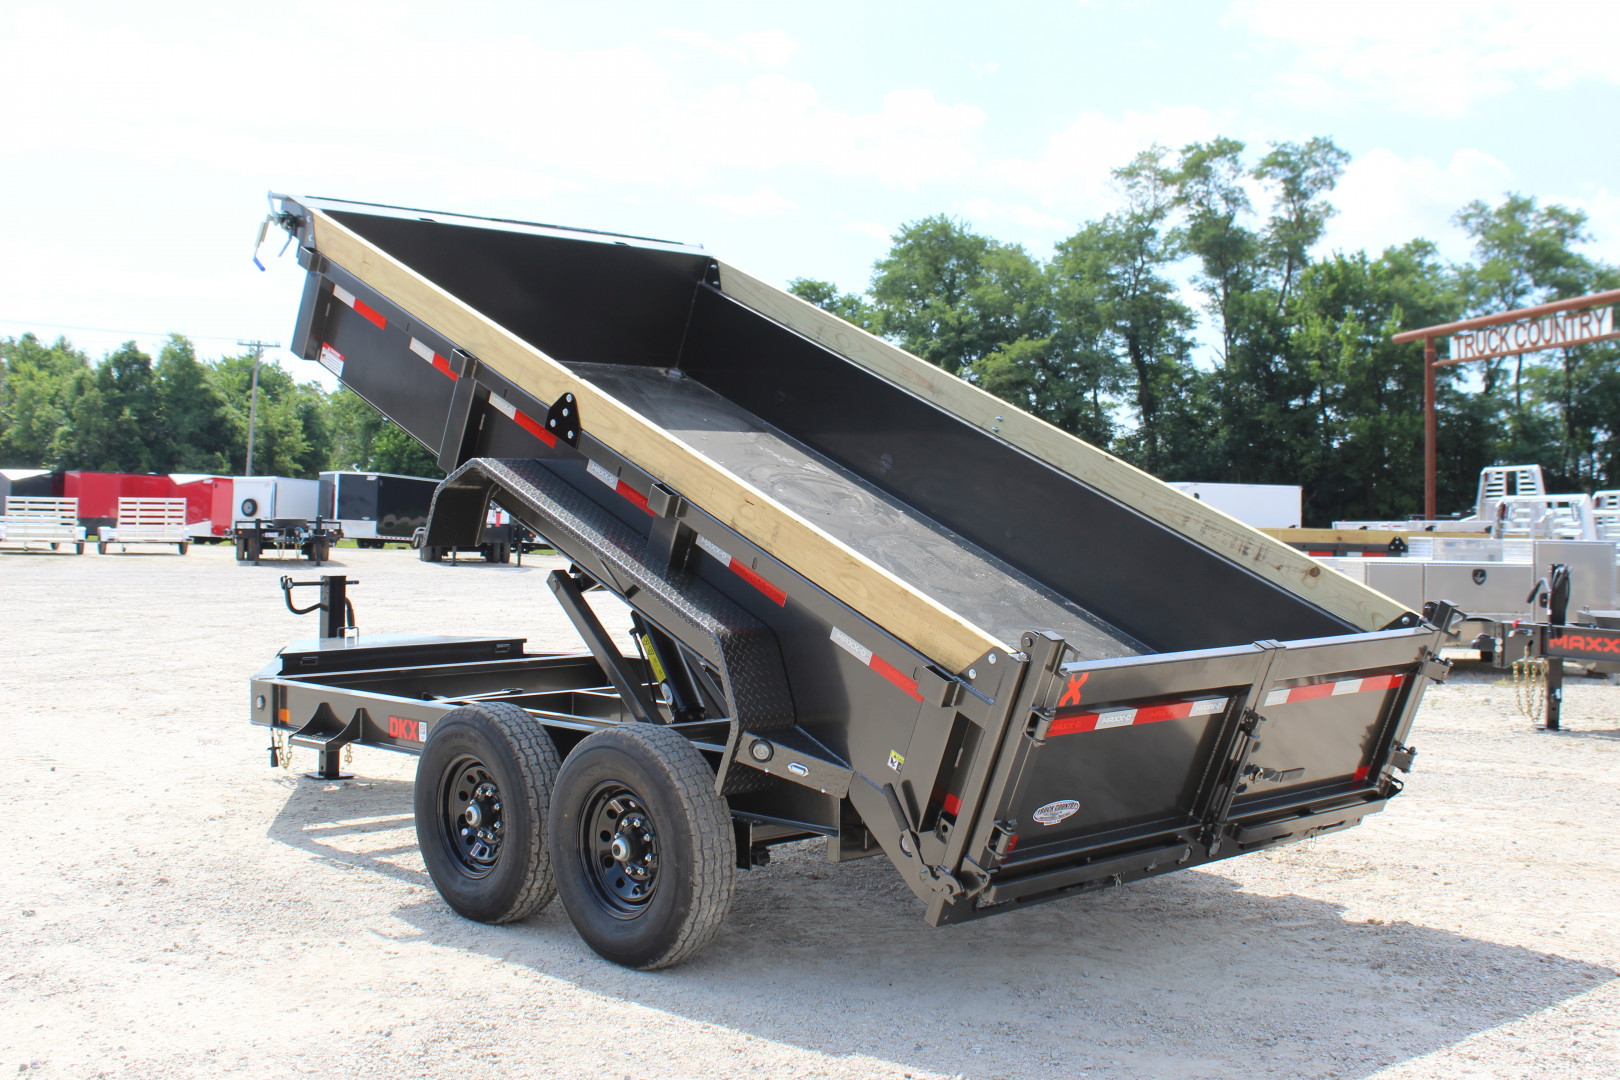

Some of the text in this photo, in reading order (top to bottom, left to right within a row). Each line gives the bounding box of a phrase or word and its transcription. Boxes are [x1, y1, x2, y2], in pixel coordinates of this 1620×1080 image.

[1453, 308, 1606, 360] TRUCK COUNTRY
[836, 631, 867, 657] MAXX-D
[1549, 634, 1620, 653] MAXX
[389, 716, 418, 742] DKX
